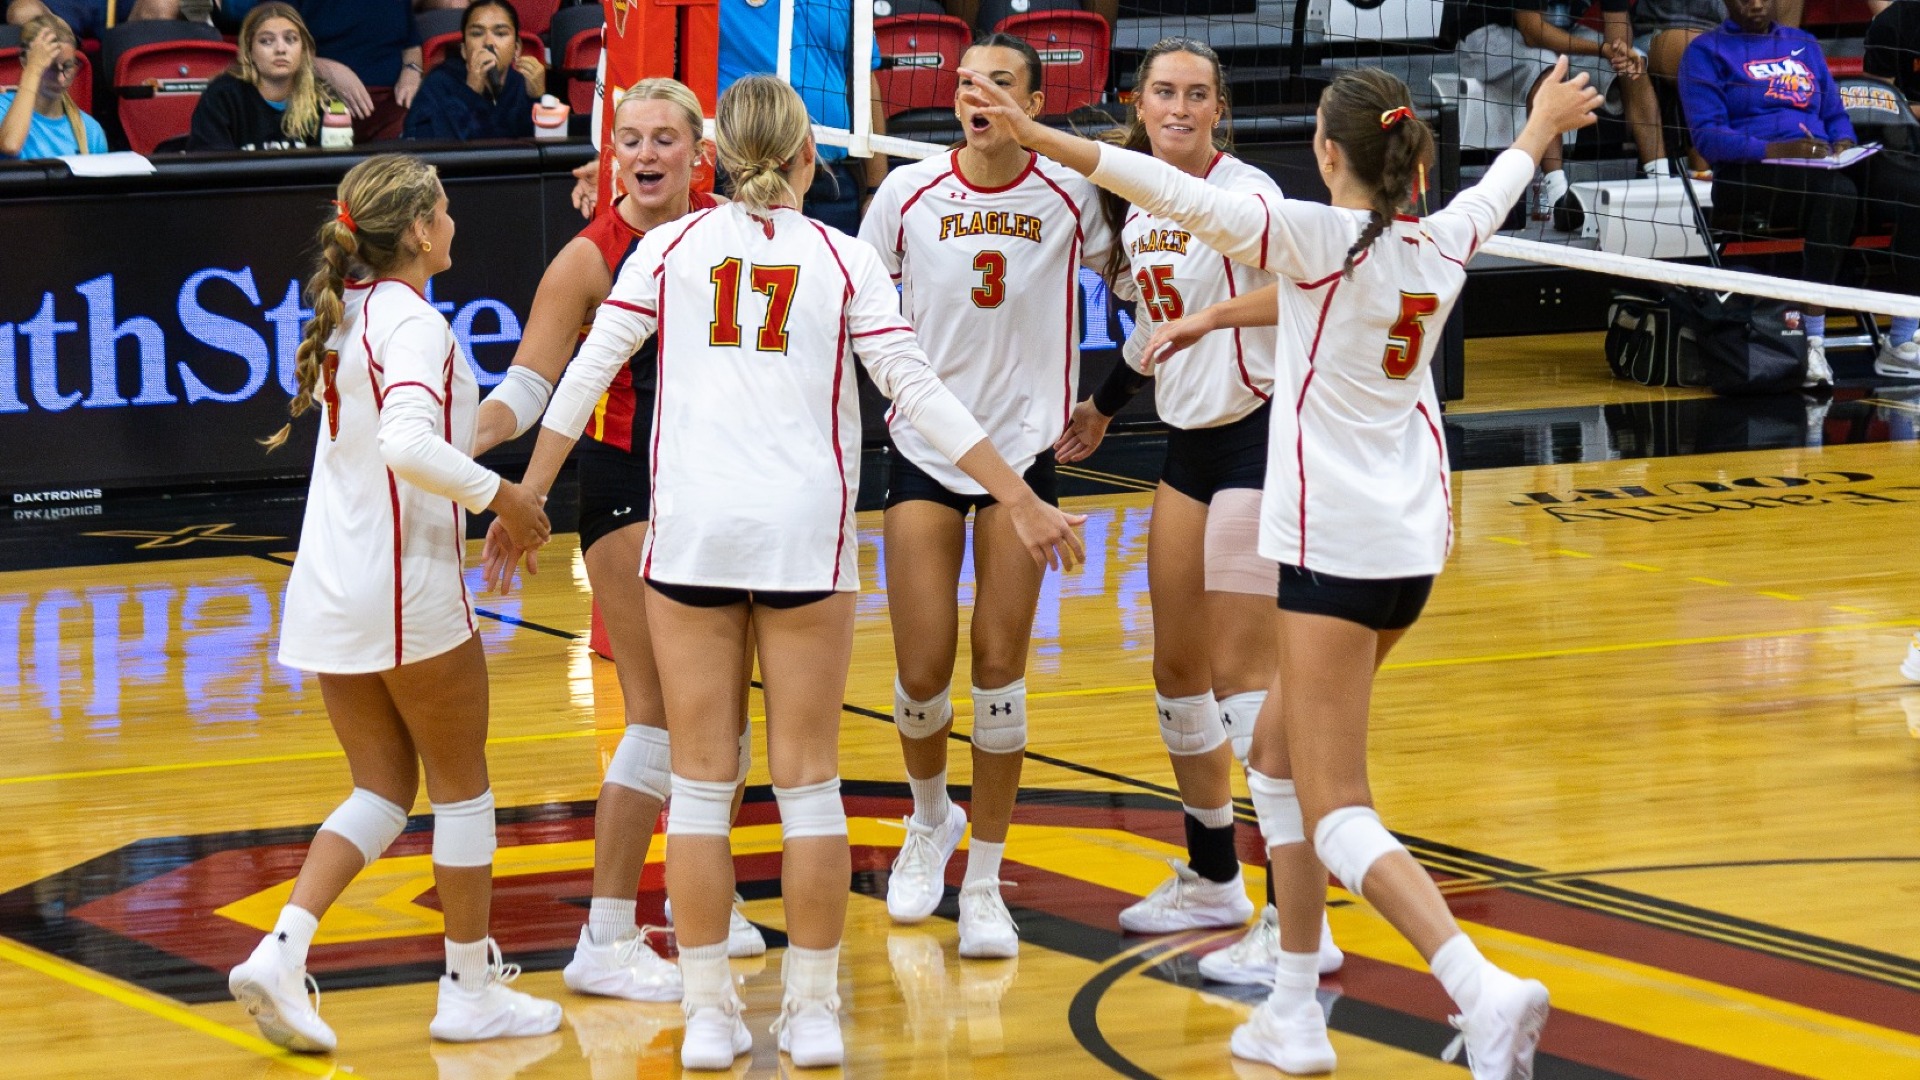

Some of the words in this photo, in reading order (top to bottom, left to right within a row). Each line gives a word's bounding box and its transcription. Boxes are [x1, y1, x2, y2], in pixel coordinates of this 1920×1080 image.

[939, 211, 1043, 243] FLAGLER
[709, 256, 801, 357] 17
[971, 249, 1007, 309] 3
[1136, 264, 1185, 322] 25
[1381, 289, 1440, 380] 5
[13, 488, 103, 503] DAKTRONICS
[1509, 472, 1875, 507] COURT
